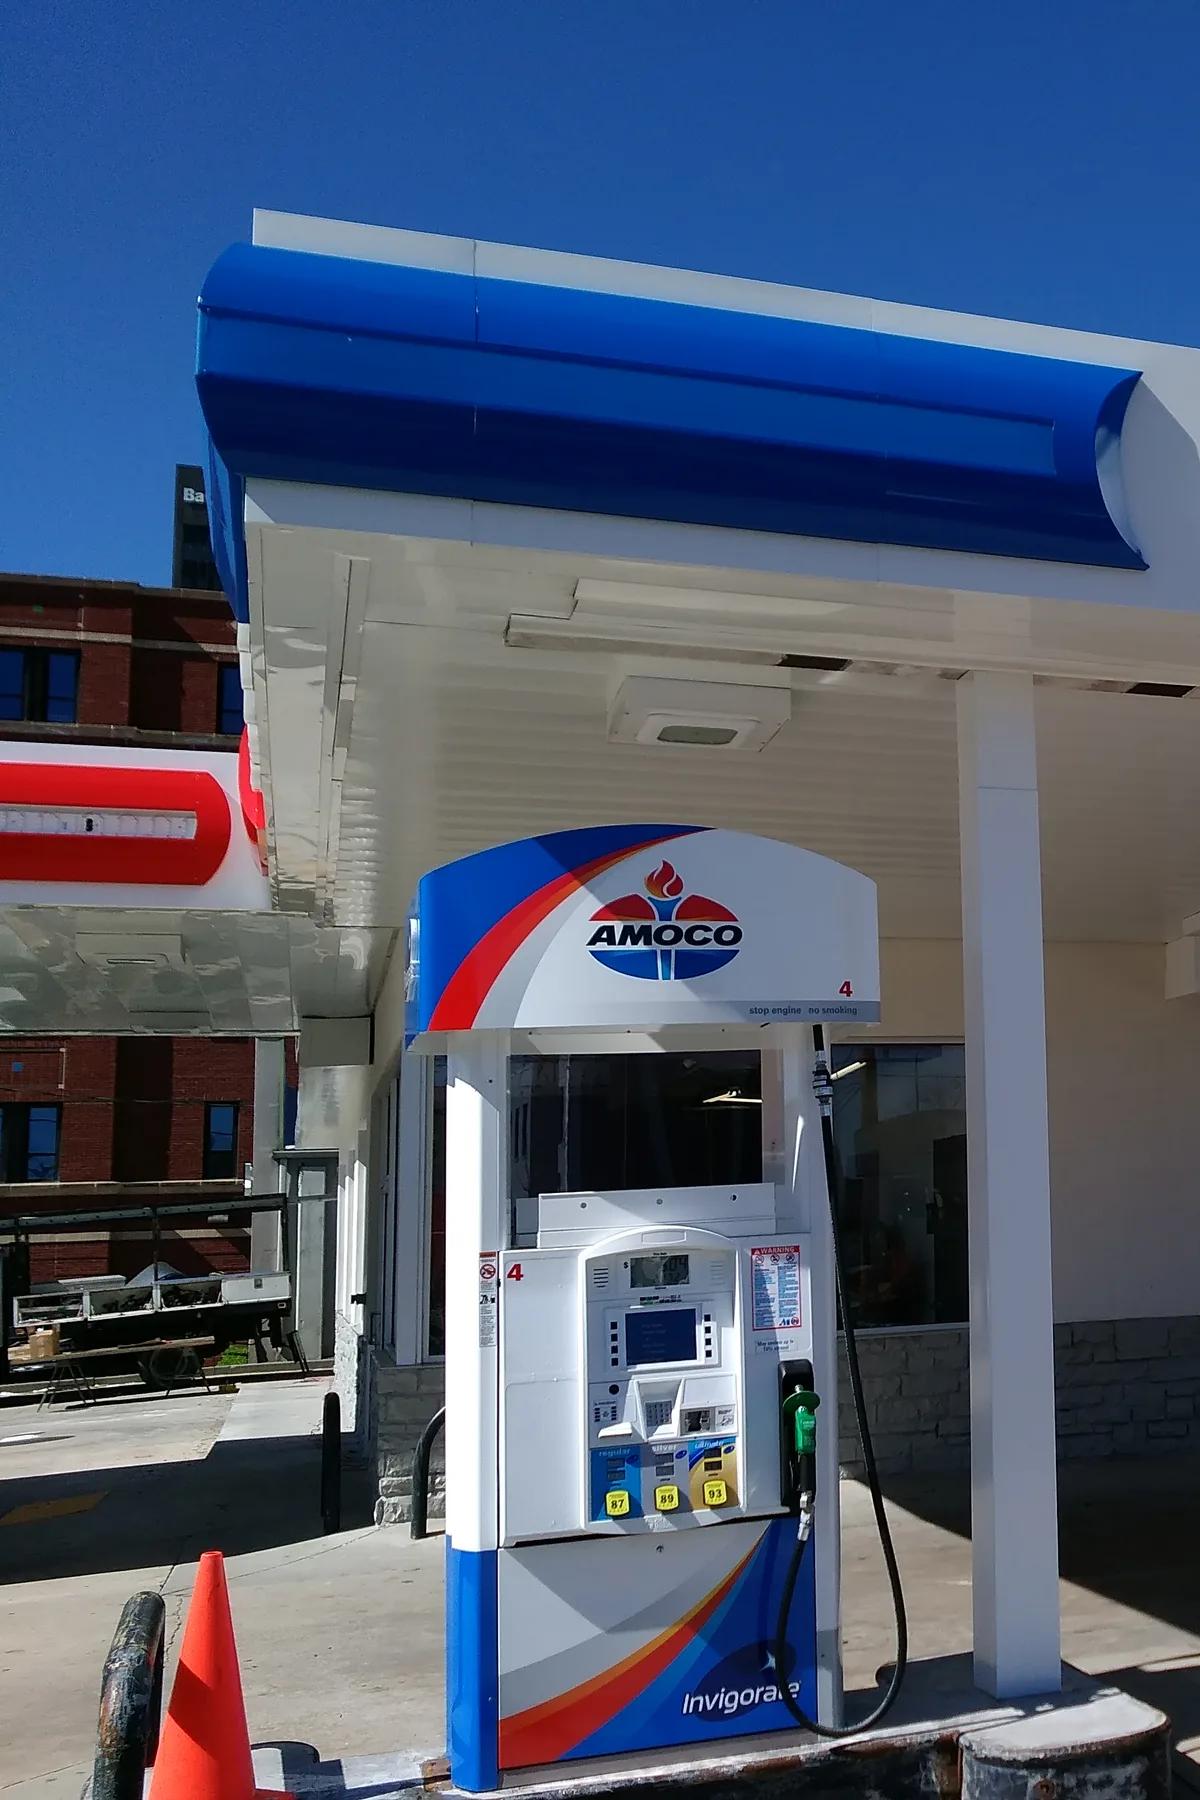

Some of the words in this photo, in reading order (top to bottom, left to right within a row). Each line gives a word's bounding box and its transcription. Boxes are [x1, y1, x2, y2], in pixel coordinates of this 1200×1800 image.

[585, 924, 743, 947] AMOCO
[839, 980, 853, 998] 4
[749, 1006, 770, 1016] stop
[771, 1005, 801, 1016] engine
[808, 1007, 820, 1015] no
[821, 1005, 858, 1016] smoking
[760, 1246, 795, 1255] WARNING
[506, 1263, 524, 1282] 4
[599, 1448, 631, 1458] regular
[651, 1444, 677, 1452] silver
[660, 1494, 674, 1504] 89
[708, 1489, 722, 1499] 93
[610, 1499, 624, 1509] 87
